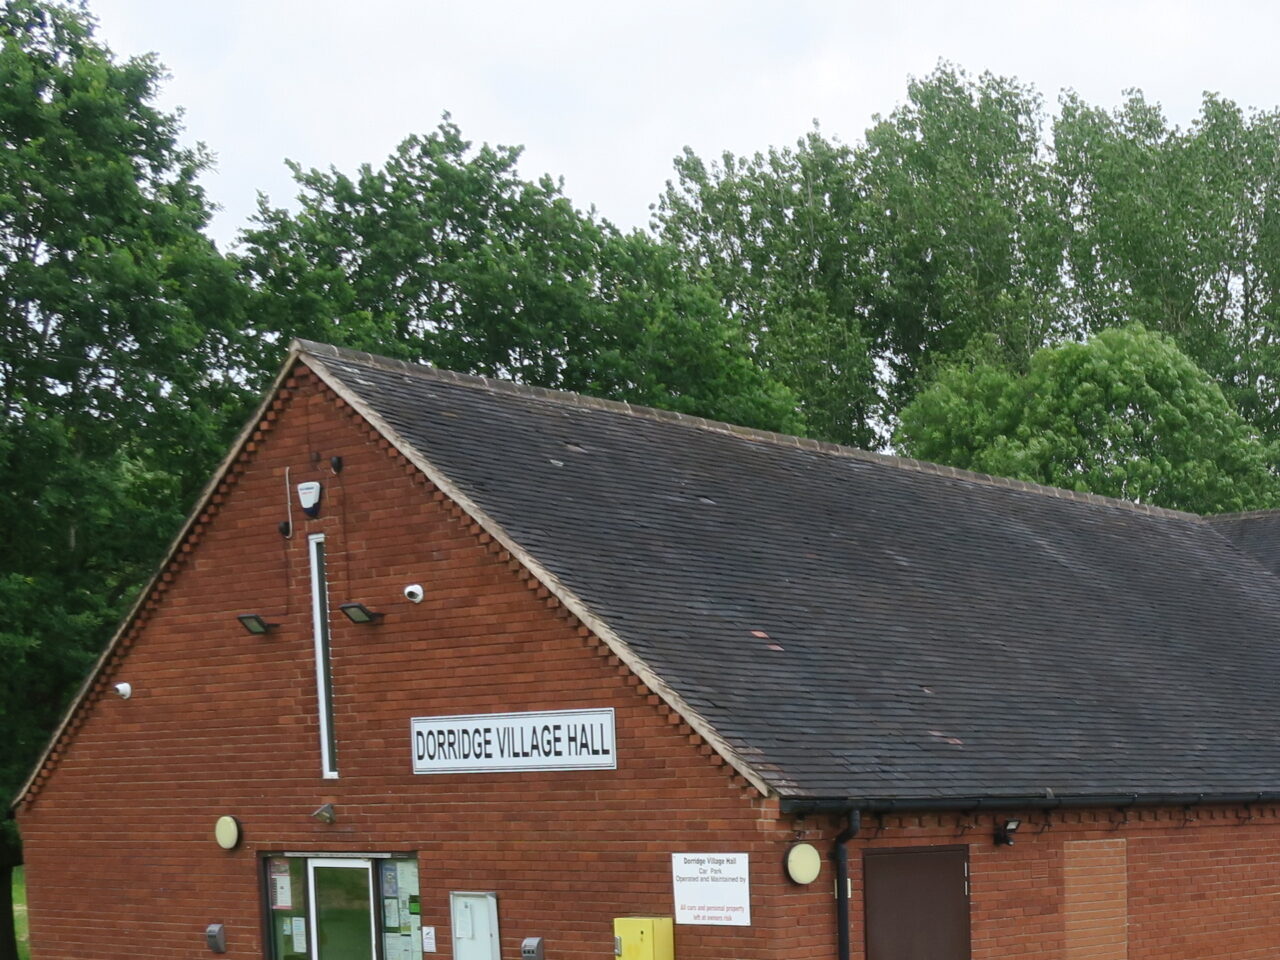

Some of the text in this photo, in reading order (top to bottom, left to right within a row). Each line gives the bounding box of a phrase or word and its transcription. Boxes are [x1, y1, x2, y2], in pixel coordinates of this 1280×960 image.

[416, 723, 611, 760] DORRIDGE VILLAGE HALL
[684, 857, 737, 866] Dorridge Village Hall
[676, 875, 698, 883] Operated
[739, 876, 746, 884] by
